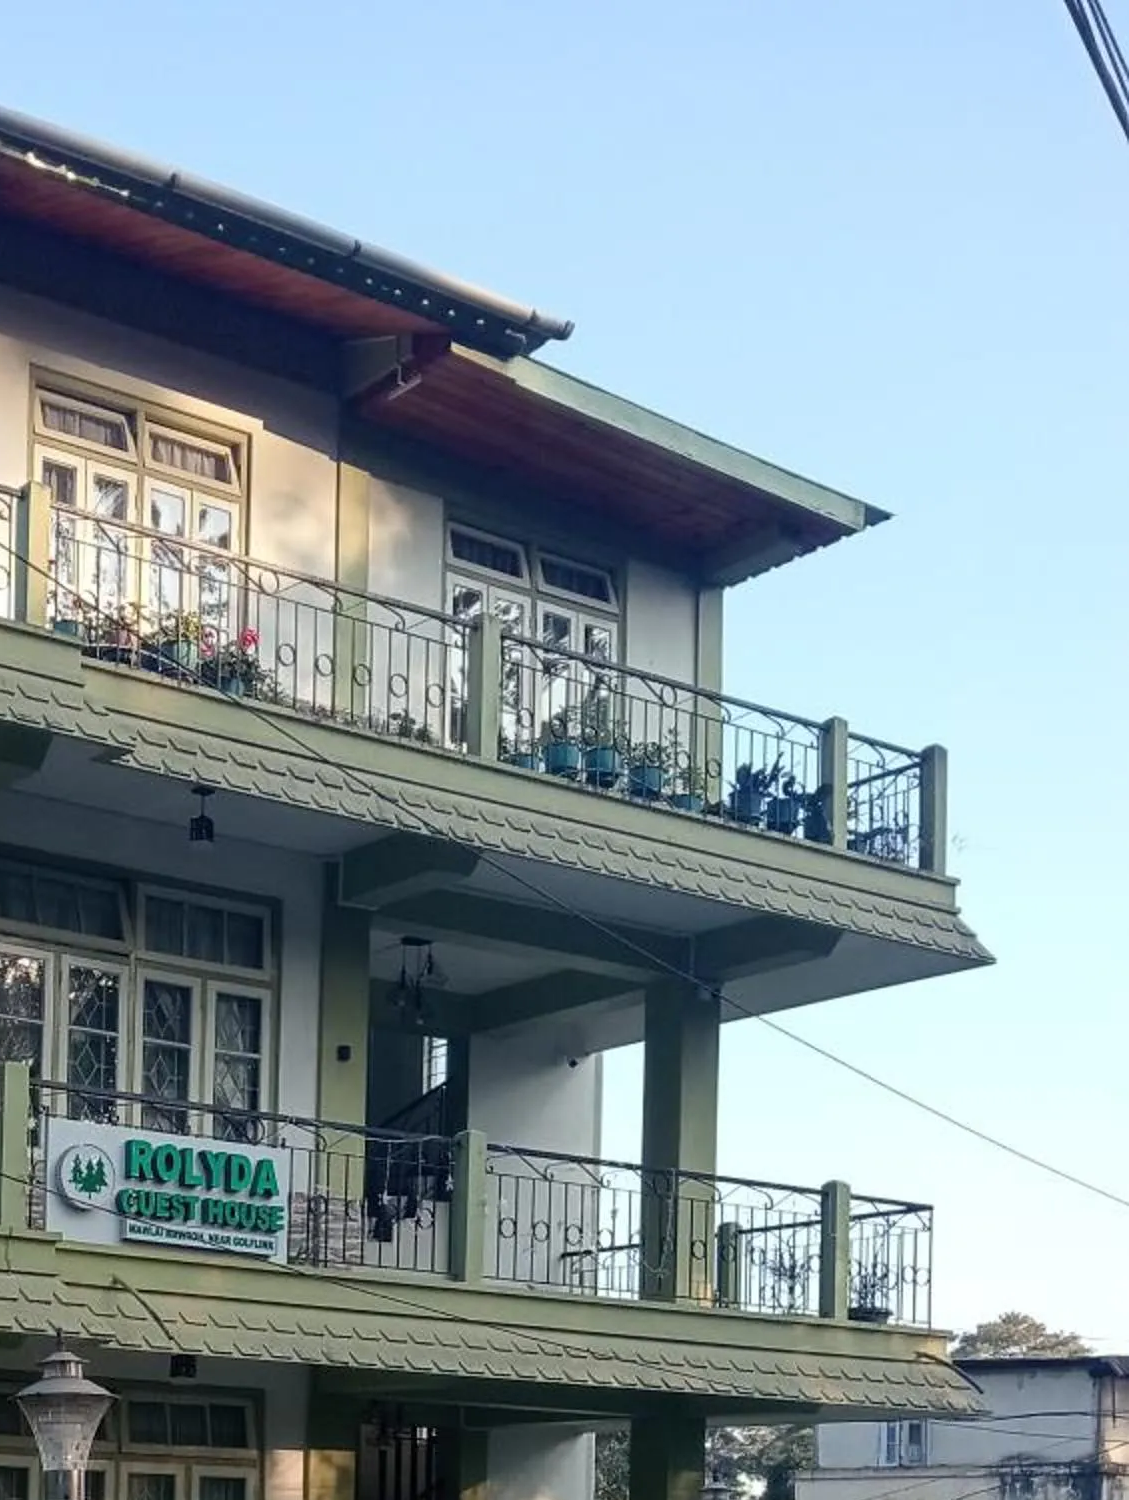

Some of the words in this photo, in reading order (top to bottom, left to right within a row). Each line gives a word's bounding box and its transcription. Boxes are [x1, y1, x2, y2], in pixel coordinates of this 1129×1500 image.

[125, 1139, 279, 1197] ROLYDA
[117, 1189, 199, 1221] GUEST
[202, 1198, 284, 1232] HOUSE
